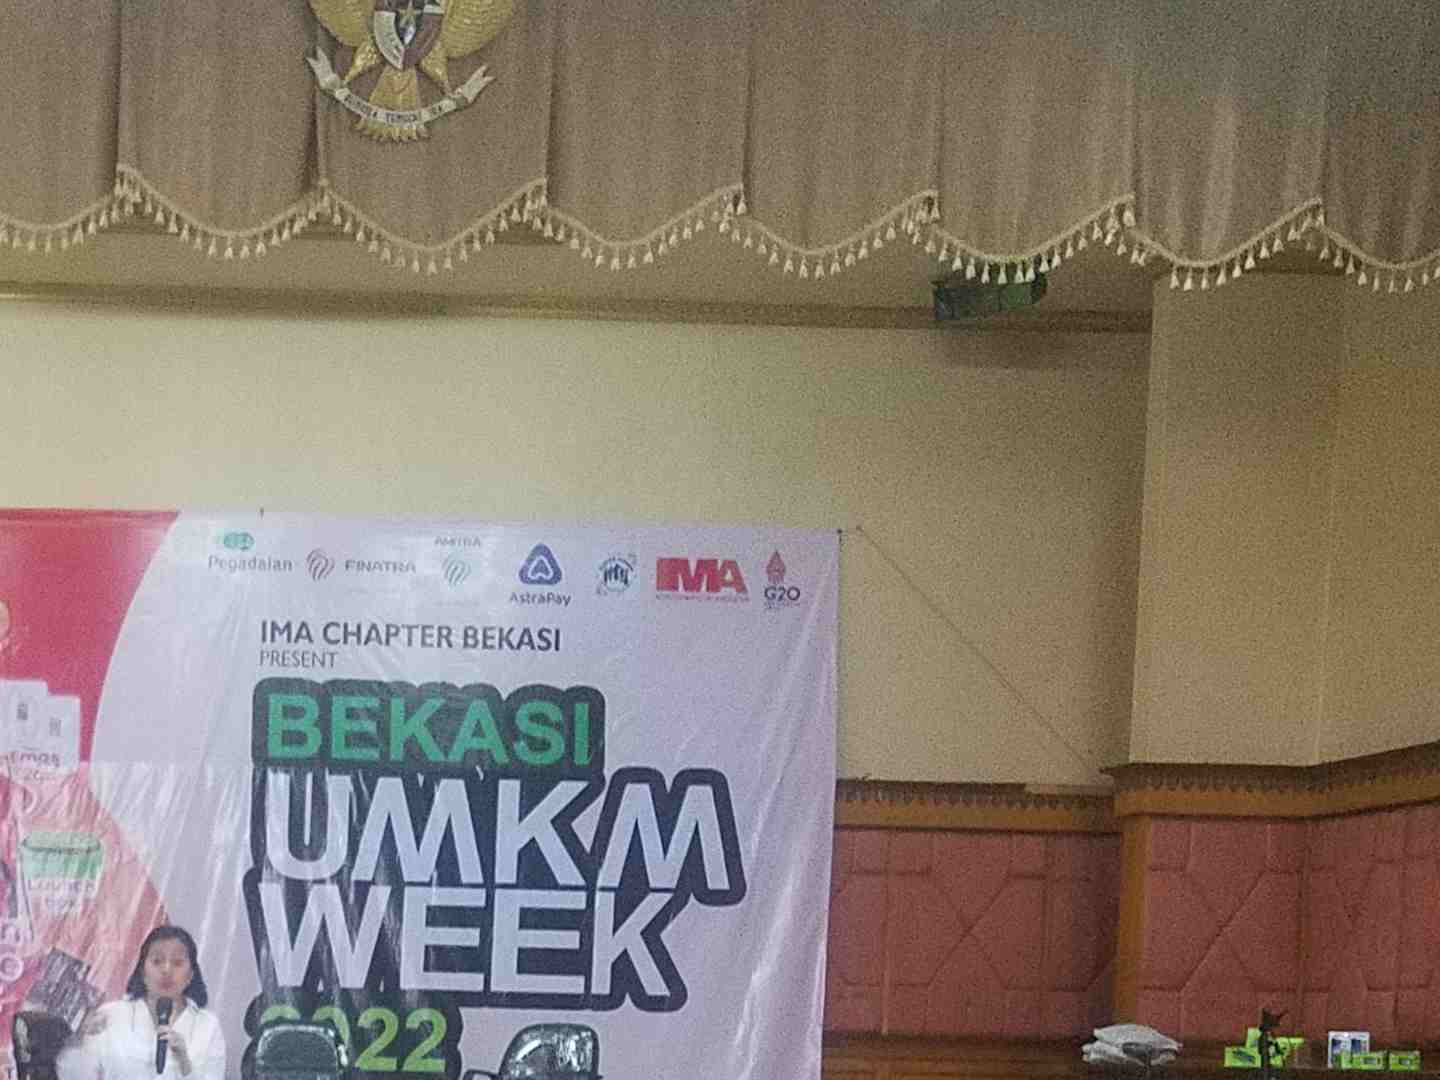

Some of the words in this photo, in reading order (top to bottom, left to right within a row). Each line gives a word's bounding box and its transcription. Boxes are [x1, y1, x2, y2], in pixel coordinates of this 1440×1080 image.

[208, 555, 293, 574] Pegadaian
[344, 560, 417, 574] FINATRA
[509, 591, 572, 607] AstraPay
[261, 620, 314, 645] IMA
[322, 621, 453, 649] CHAPTER
[462, 625, 561, 653] BEKASI
[259, 650, 340, 668] PRESENT
[266, 693, 591, 766] BEKASI
[261, 770, 731, 892] UMKM
[260, 877, 673, 997] WEEK
[261, 1004, 448, 1072] 22
